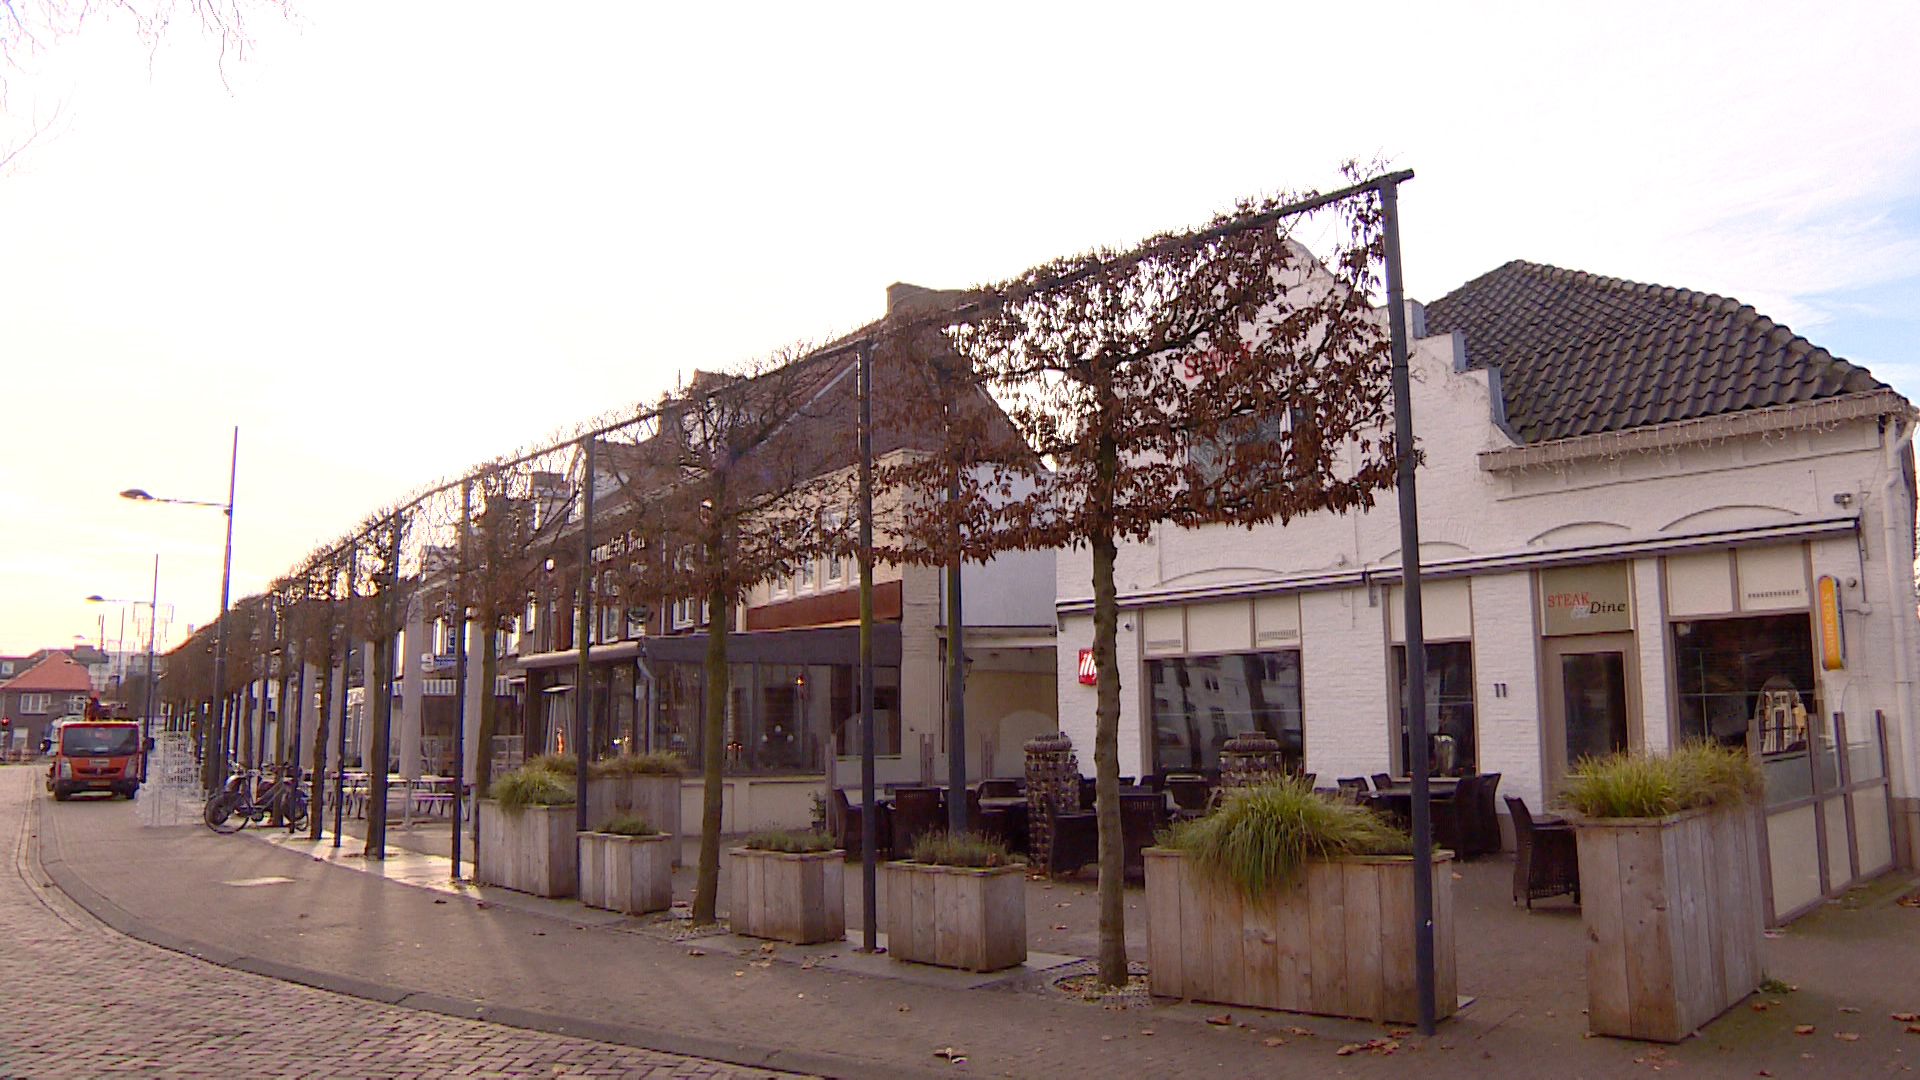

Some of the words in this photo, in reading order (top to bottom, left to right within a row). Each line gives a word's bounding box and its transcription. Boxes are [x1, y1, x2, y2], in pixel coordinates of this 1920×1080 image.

[1548, 592, 1590, 608] STEAK
[1590, 602, 1626, 614] Dine
[1493, 683, 1507, 698] 11
